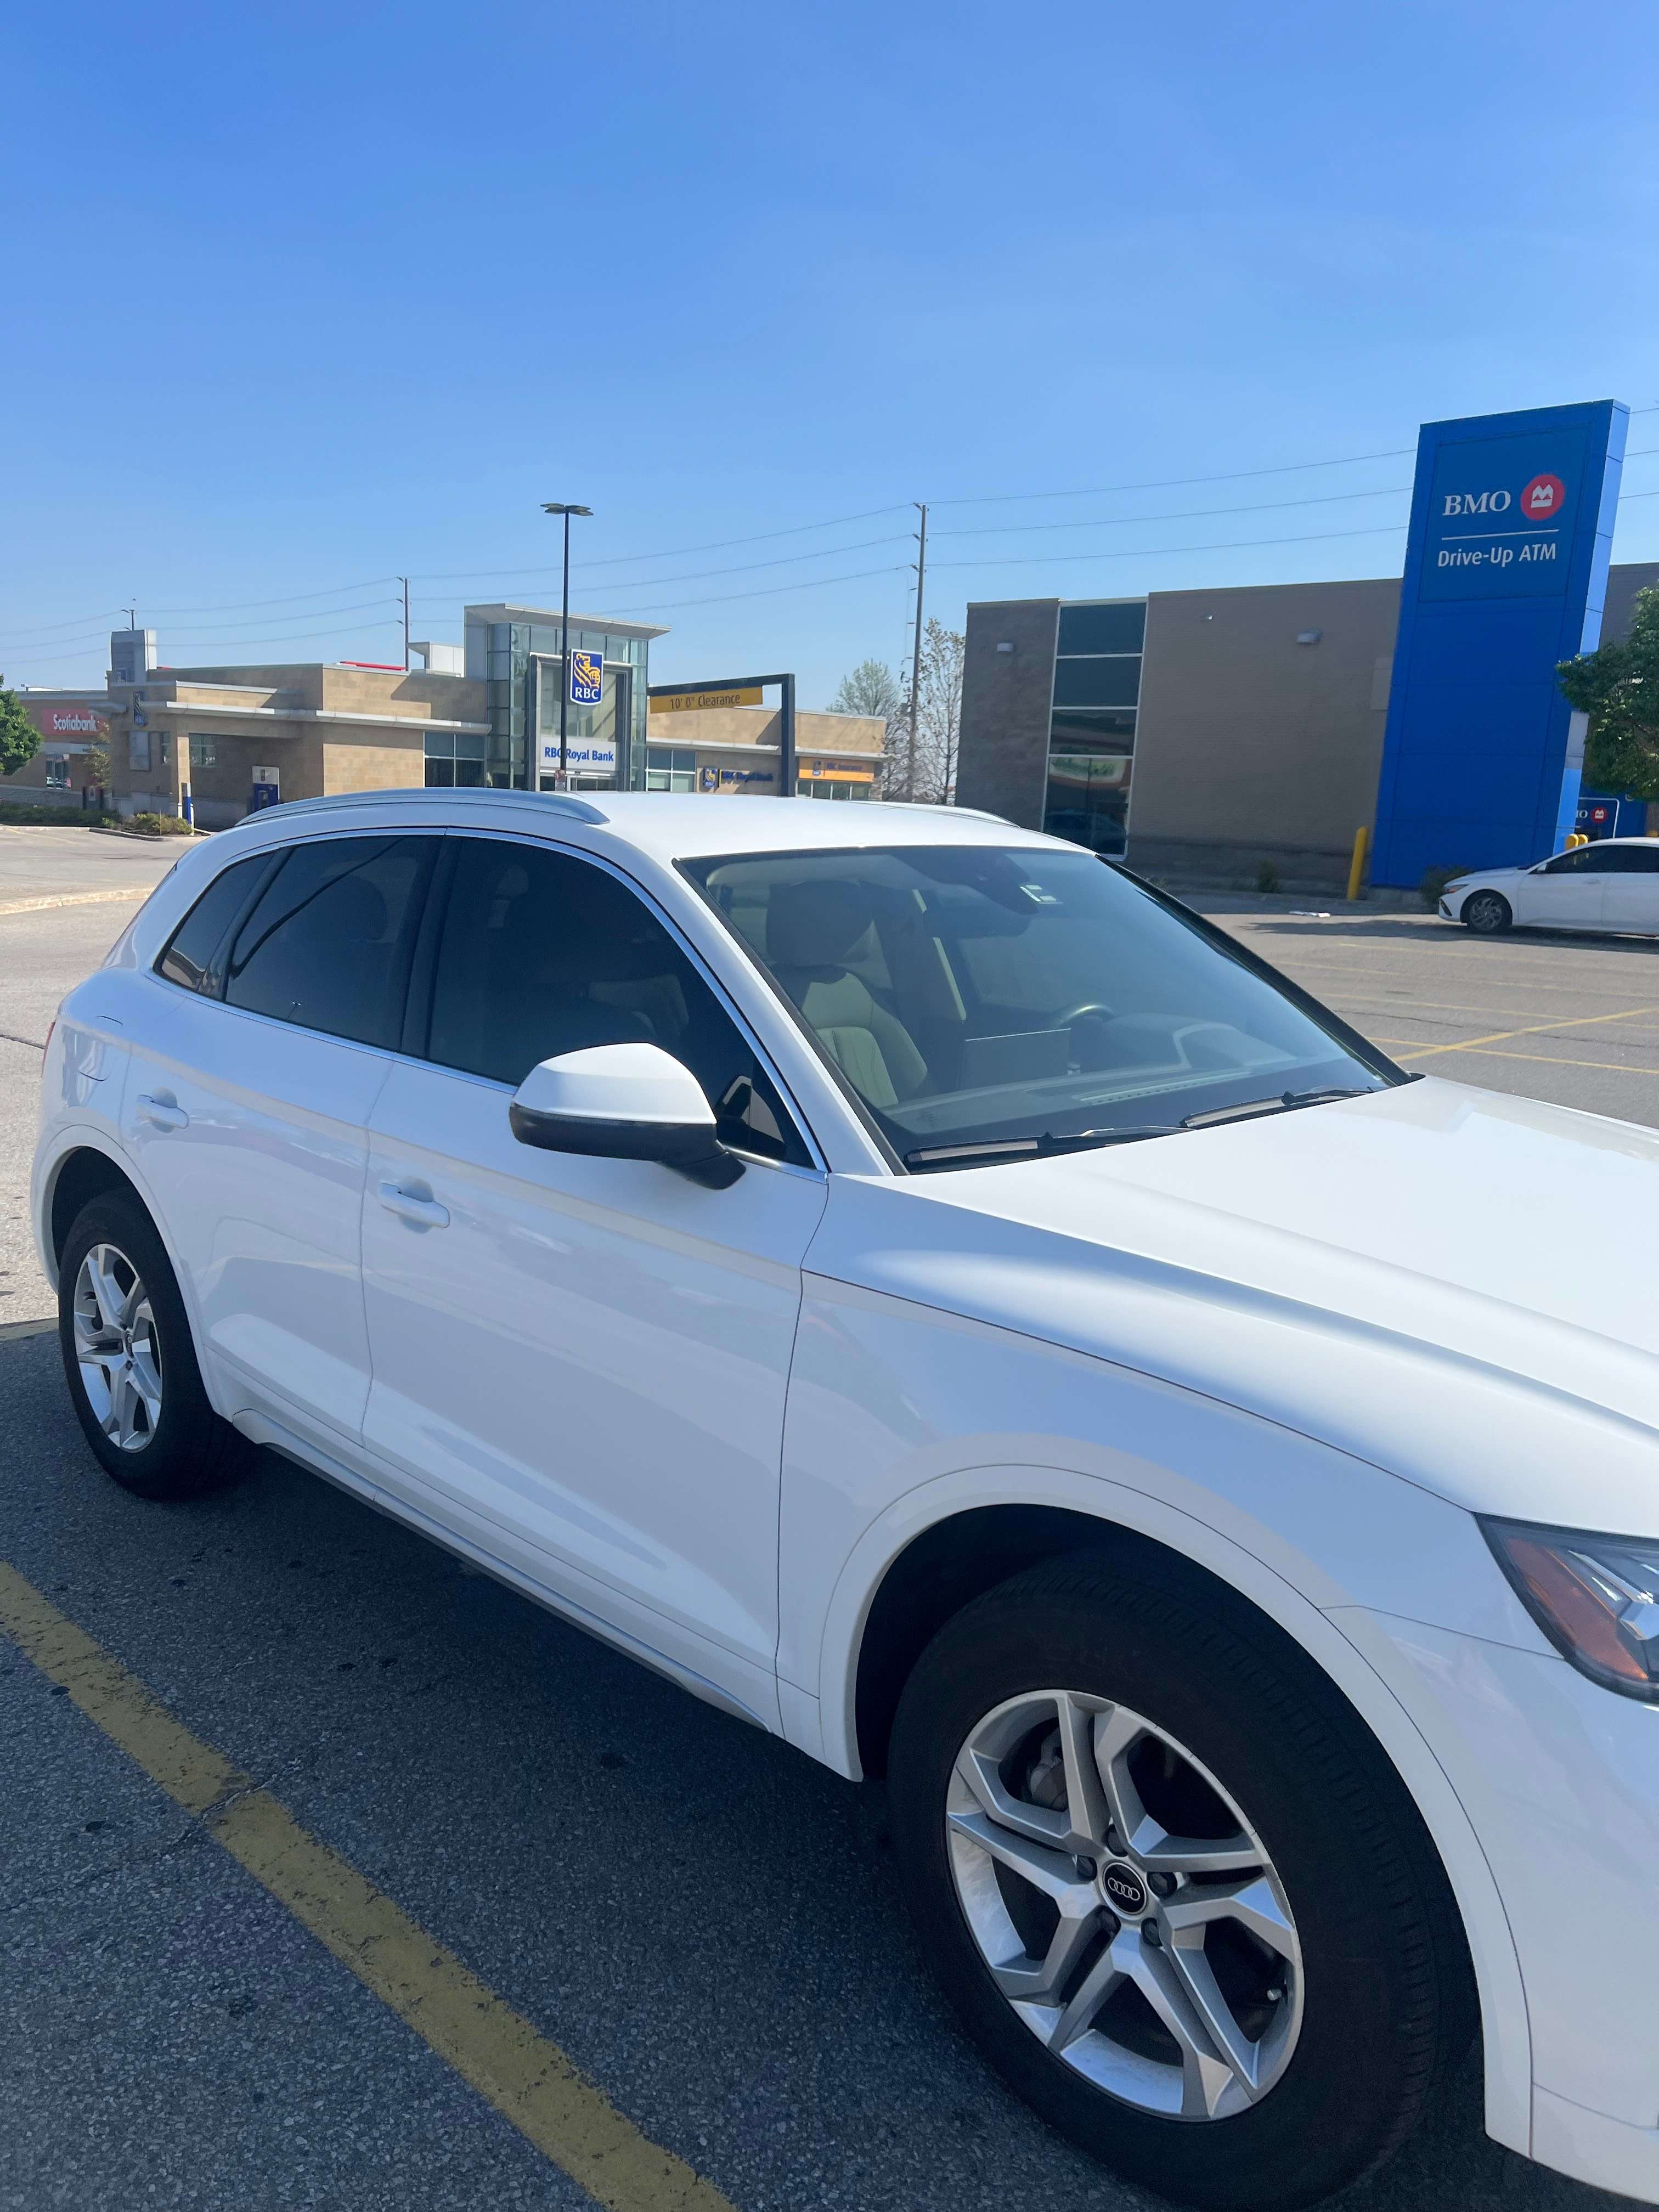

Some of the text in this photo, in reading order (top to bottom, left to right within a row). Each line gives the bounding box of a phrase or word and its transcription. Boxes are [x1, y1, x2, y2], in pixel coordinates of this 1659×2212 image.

[1442, 490, 1511, 516] BMO
[1437, 543, 1556, 567] Drive-Up ATM
[575, 686, 599, 699] RBC
[698, 694, 741, 707] Clearance
[53, 714, 97, 732] Scotiabank
[566, 748, 589, 762] Royal
[592, 750, 614, 761] Bank
